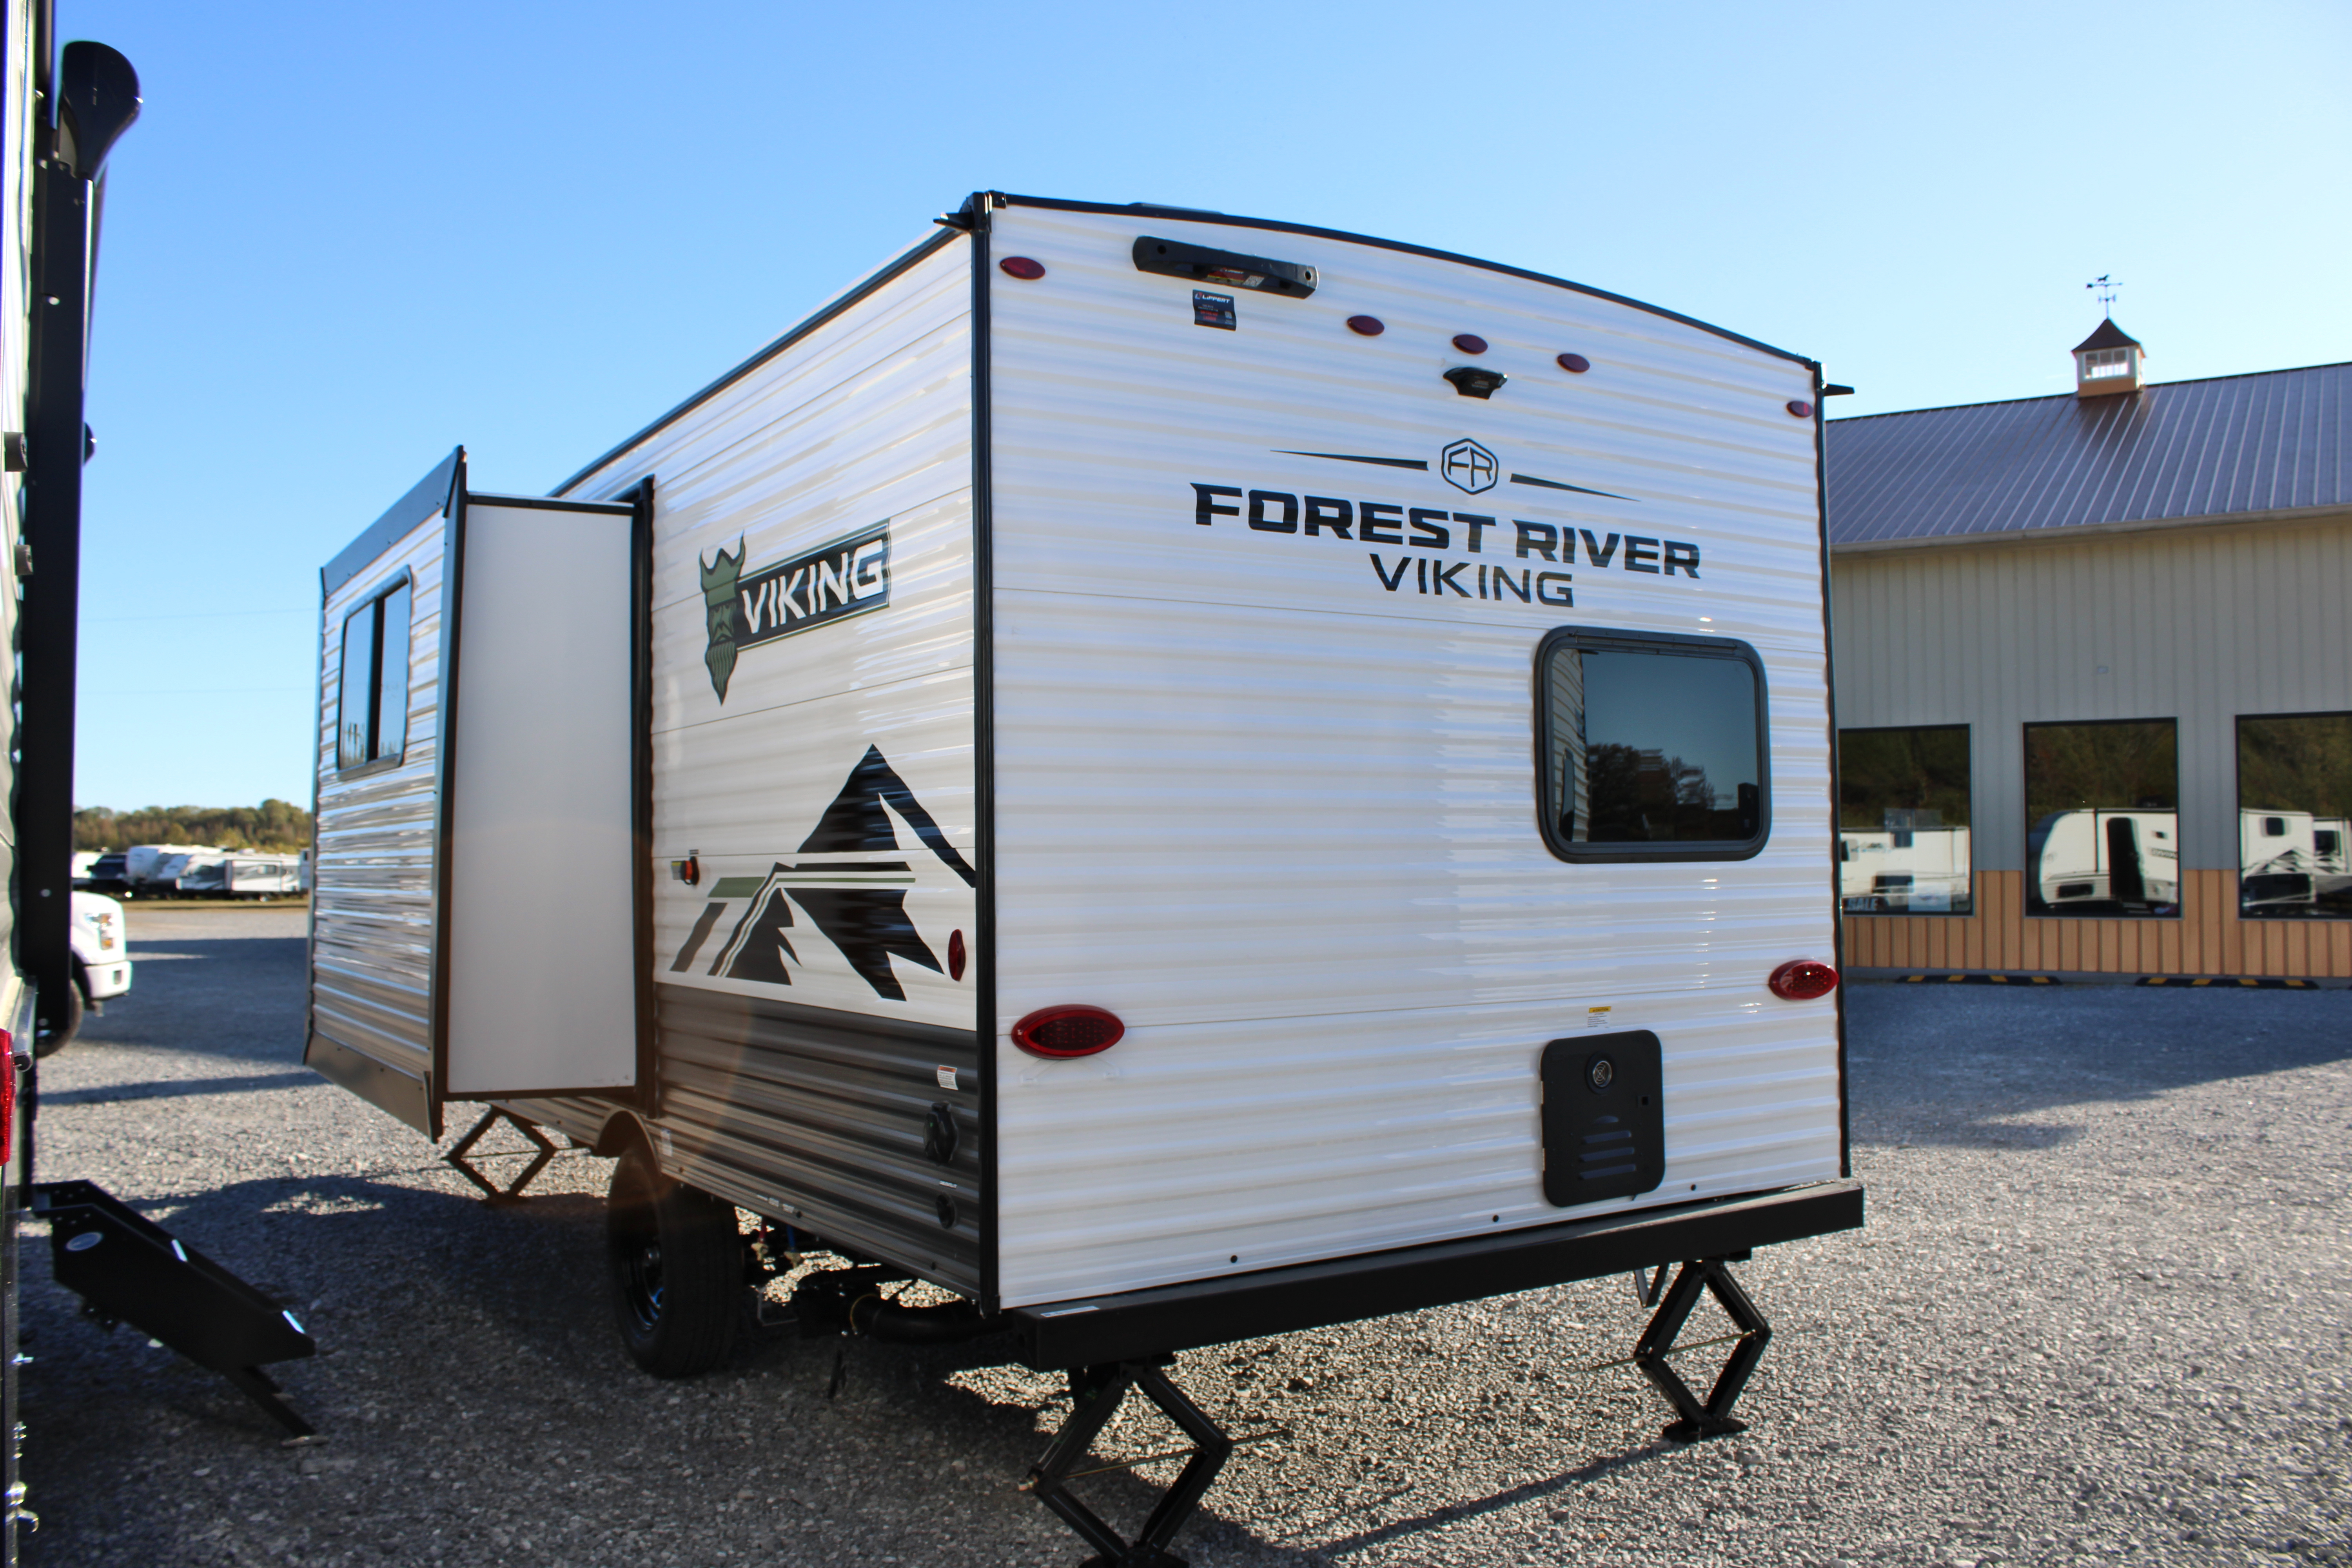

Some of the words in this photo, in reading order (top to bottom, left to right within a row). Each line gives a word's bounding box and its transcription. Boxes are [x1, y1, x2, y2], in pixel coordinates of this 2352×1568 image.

[1447, 446, 1493, 488] FR
[1190, 483, 1497, 553] FOREST
[1512, 520, 1700, 579] RIVER
[741, 538, 884, 635] VIKING
[1369, 553, 1573, 608] VIKING
